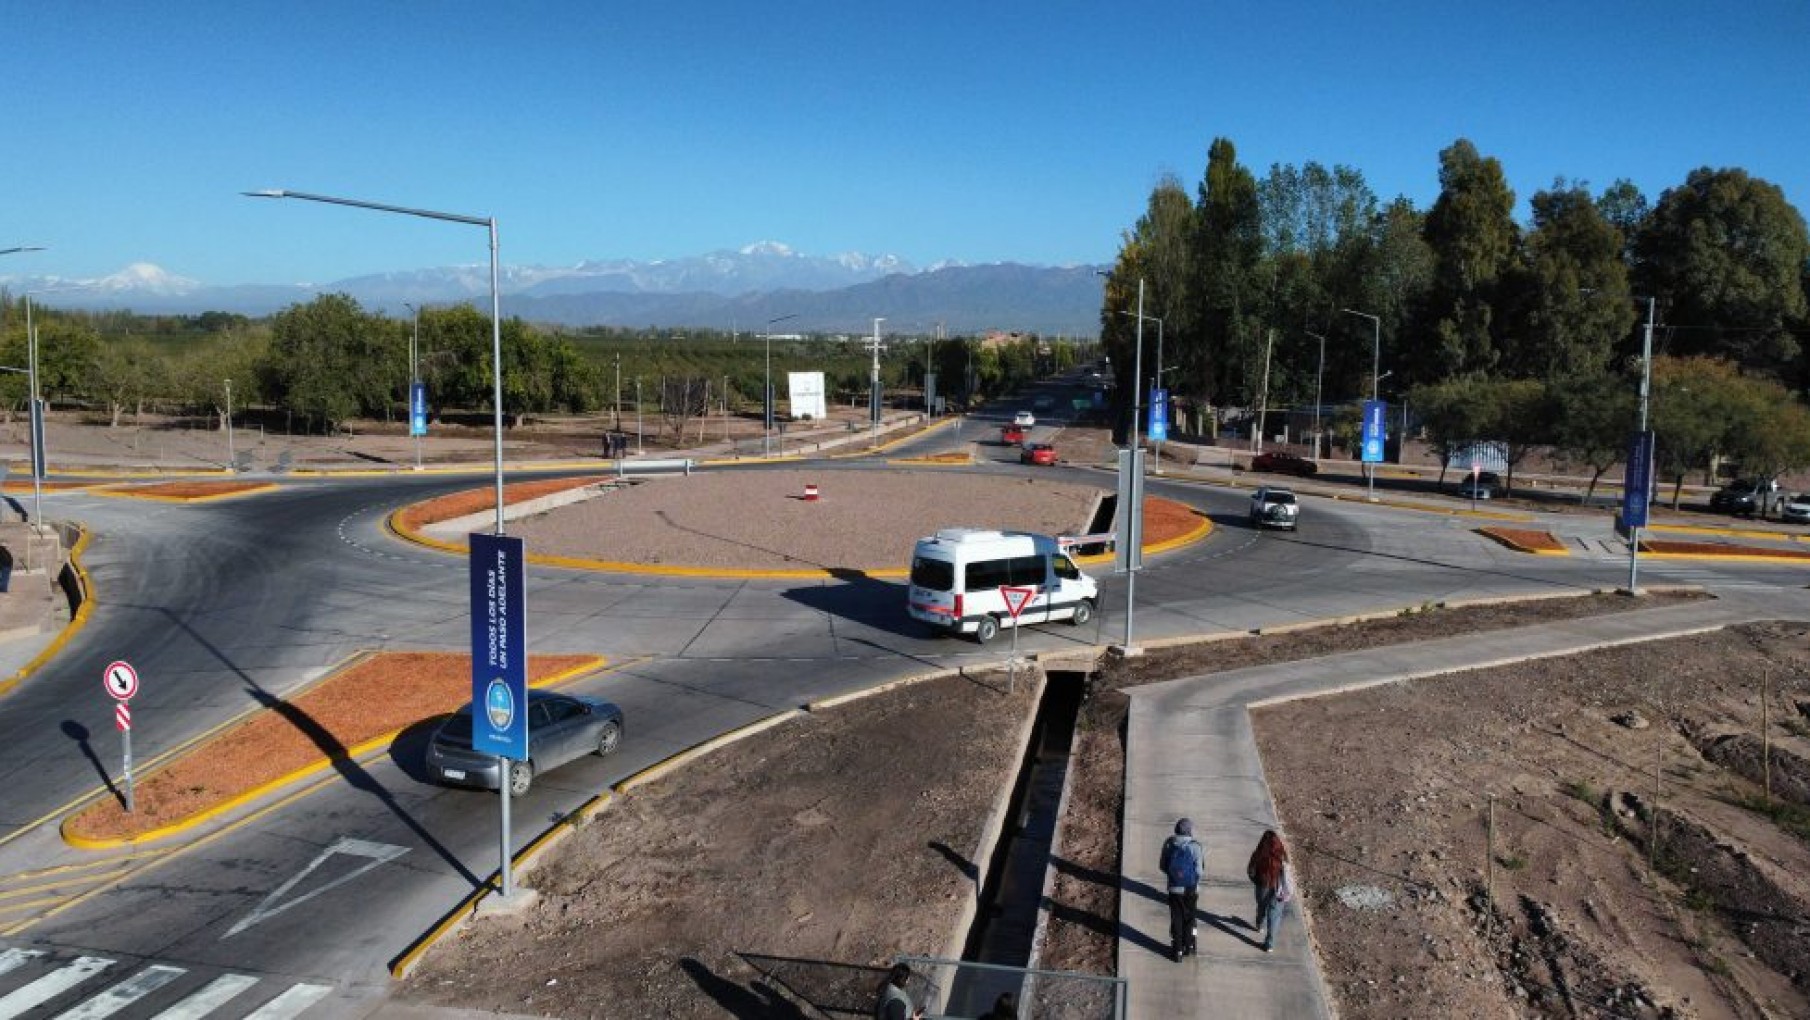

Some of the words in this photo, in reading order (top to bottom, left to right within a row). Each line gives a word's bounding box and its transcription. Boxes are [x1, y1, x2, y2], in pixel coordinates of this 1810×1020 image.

[487, 570, 496, 598] DÍAS
[497, 549, 507, 616] ADELANTE
[488, 600, 497, 624] LOS
[488, 625, 497, 666] TODOS
[498, 617, 507, 650] PASO
[499, 651, 507, 669] UN
